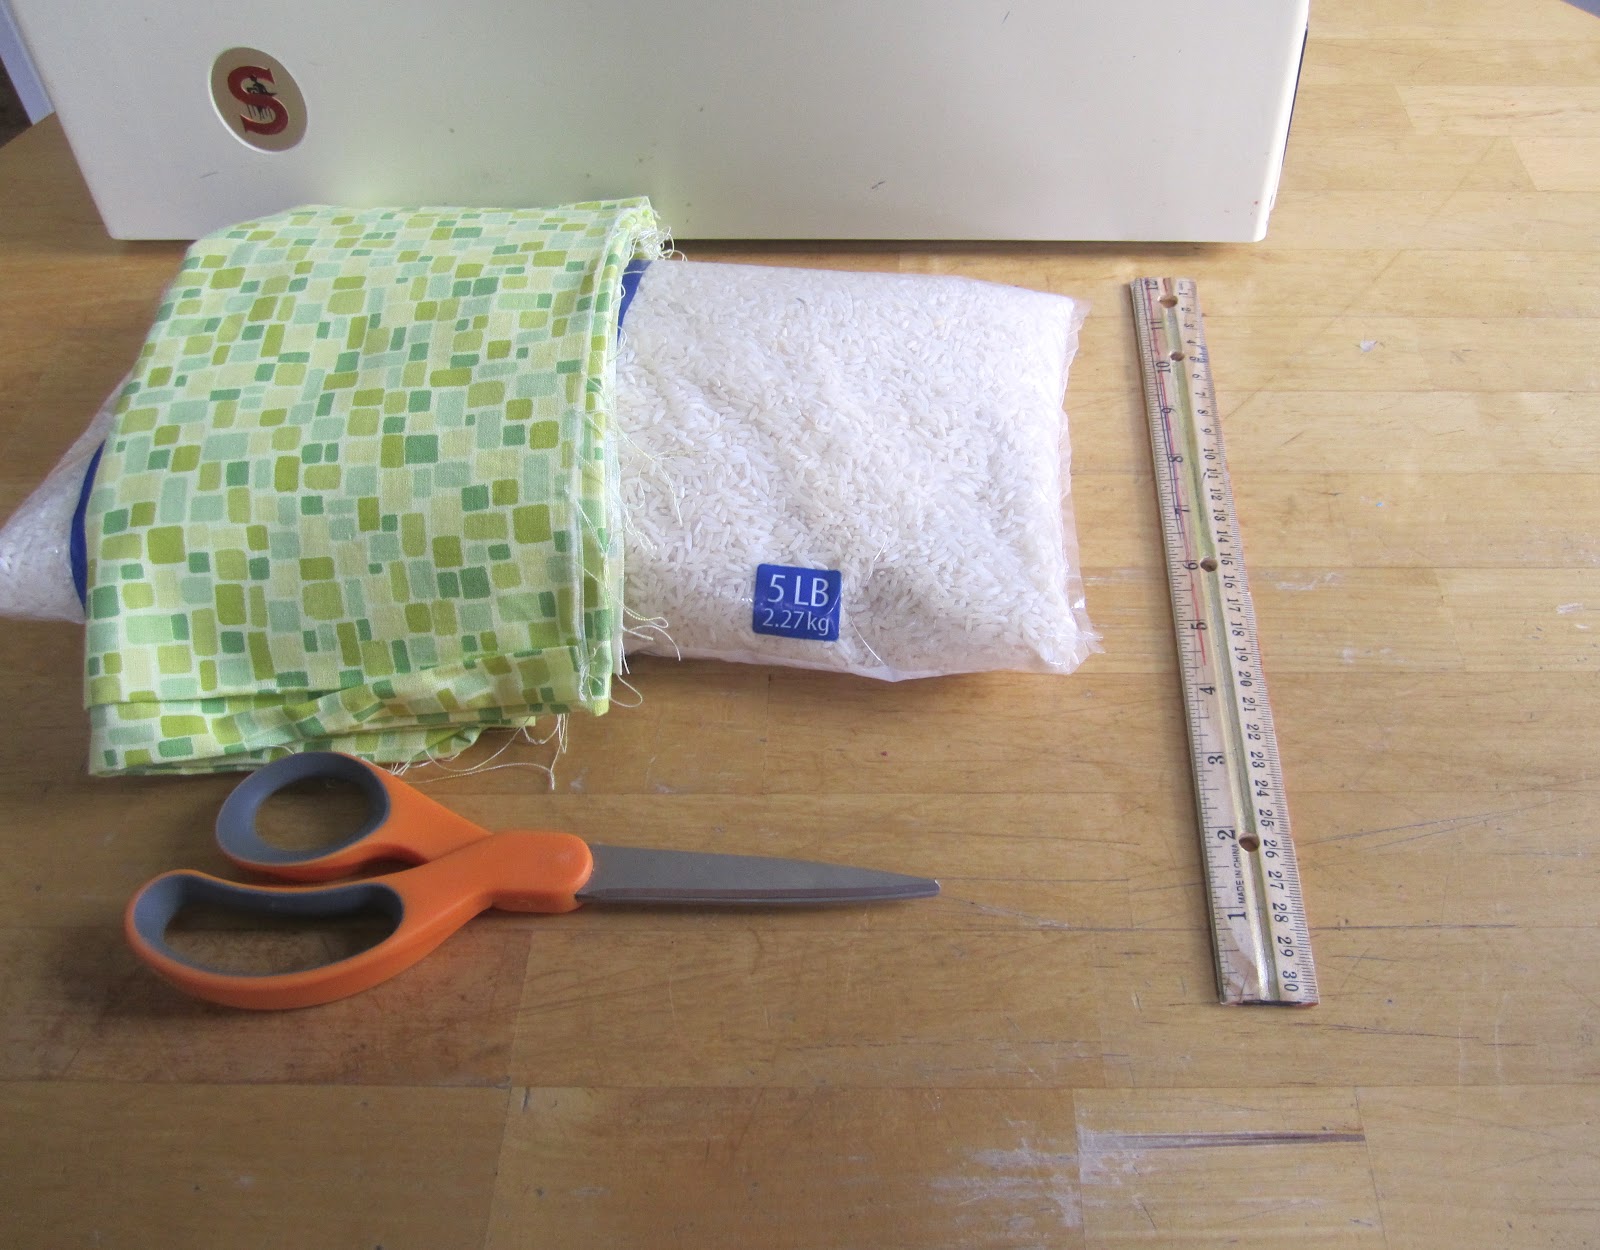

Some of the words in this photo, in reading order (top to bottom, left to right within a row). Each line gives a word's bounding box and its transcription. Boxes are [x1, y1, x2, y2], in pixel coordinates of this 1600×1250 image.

[227, 65, 289, 136] S
[1150, 321, 1163, 331] 11
[1156, 361, 1171, 374] 10
[1169, 455, 1183, 463] 8
[1203, 448, 1216, 460] 10
[1206, 468, 1219, 478] 11
[1210, 488, 1223, 500] 12
[1213, 509, 1226, 521] 13
[1216, 530, 1230, 543] 14
[1220, 552, 1233, 565] 15
[1183, 562, 1198, 570] 6
[1223, 575, 1237, 589] 16
[767, 574, 786, 603] 5
[794, 575, 829, 607] LB
[1227, 598, 1241, 612] 17
[762, 608, 830, 636] 2.27kg
[1190, 622, 1208, 631] 5
[1230, 622, 1245, 637] 18
[1234, 647, 1248, 662] 19
[1238, 671, 1253, 687] 20
[1199, 686, 1216, 695] 4
[1242, 697, 1256, 712] 21
[1246, 724, 1261, 740] 22
[1208, 755, 1225, 765] 3
[1250, 751, 1265, 768] 23
[1254, 780, 1270, 797] 24
[1259, 809, 1275, 827] 25
[1217, 829, 1236, 840] 2
[1263, 839, 1279, 858] 26
[1231, 844, 1242, 869] CHINA
[1234, 870, 1243, 878] IN
[1268, 870, 1284, 890] 27
[1235, 880, 1246, 904] MADE
[1227, 912, 1247, 920] 1
[1272, 902, 1289, 923] 28
[1277, 936, 1294, 957] 29
[1282, 970, 1299, 992] 30
